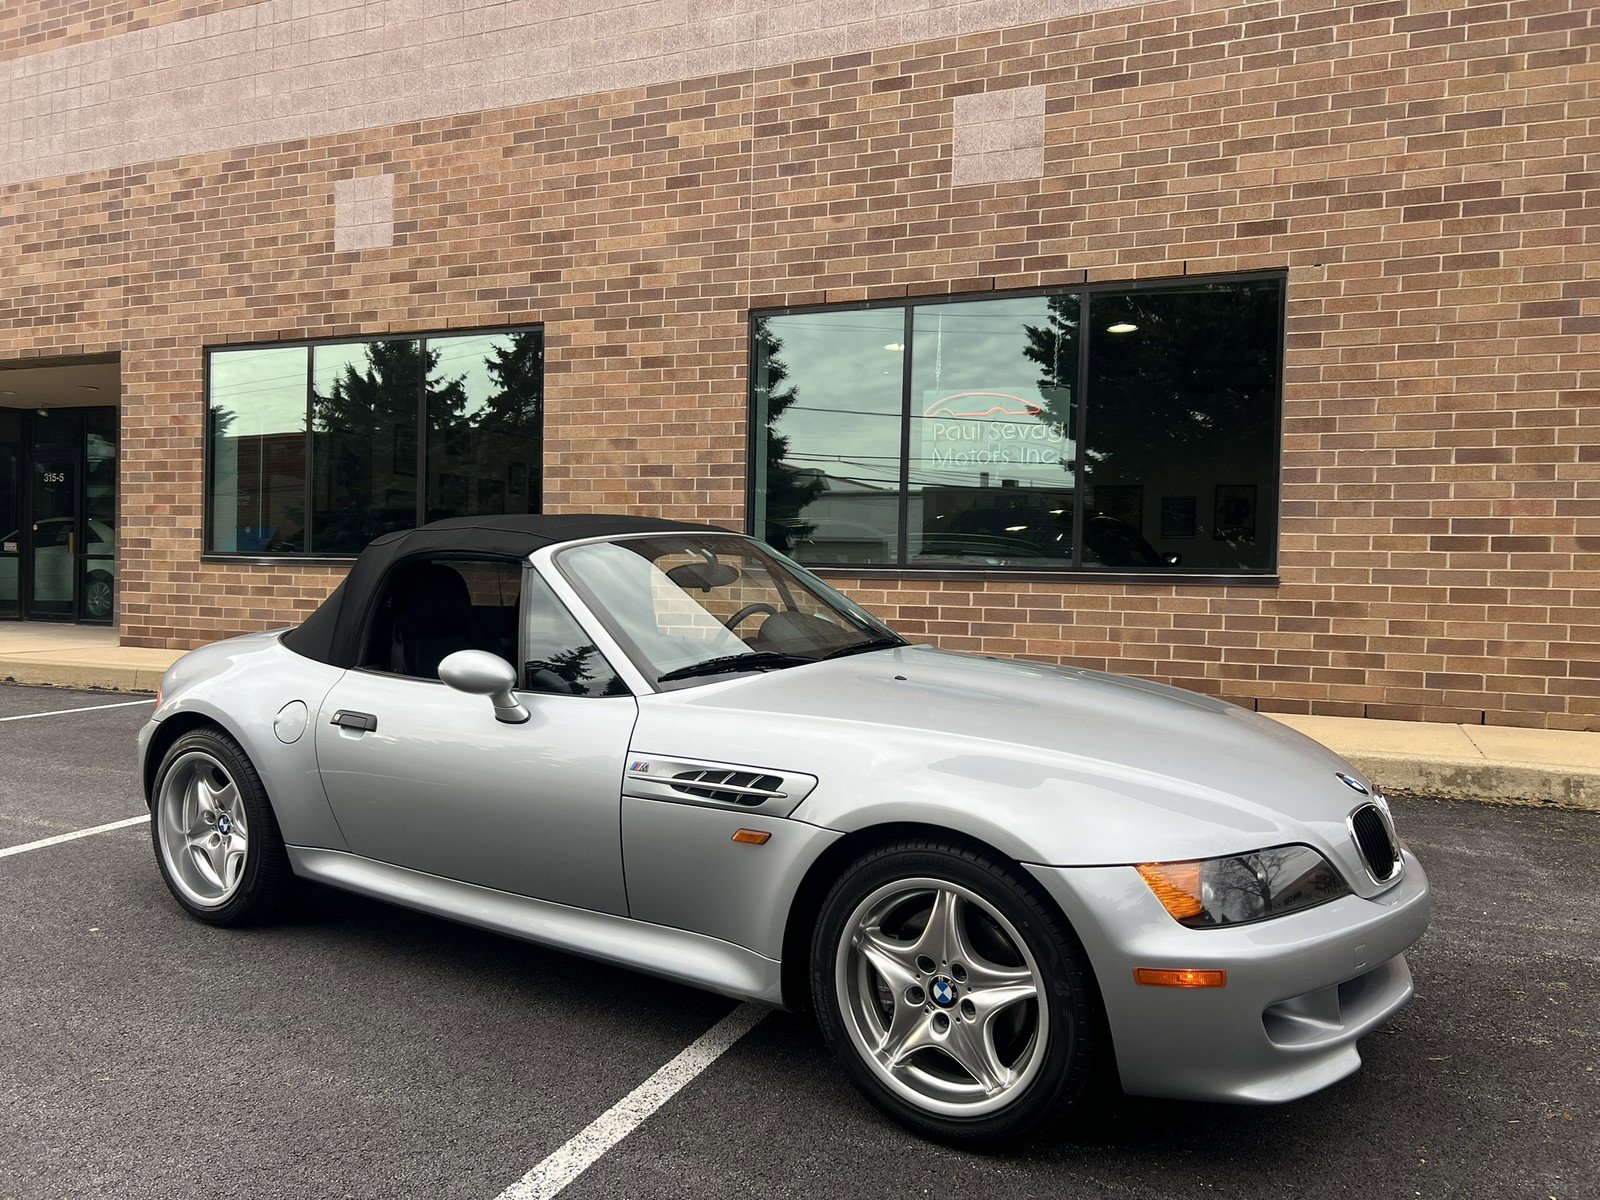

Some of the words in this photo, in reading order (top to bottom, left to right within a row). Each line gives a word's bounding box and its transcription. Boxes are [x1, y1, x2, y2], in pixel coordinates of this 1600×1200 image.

[933, 421, 980, 441] Paul
[988, 421, 1064, 443] Sevag
[932, 446, 1010, 466] Motors
[43, 472, 65, 482] 315-5
